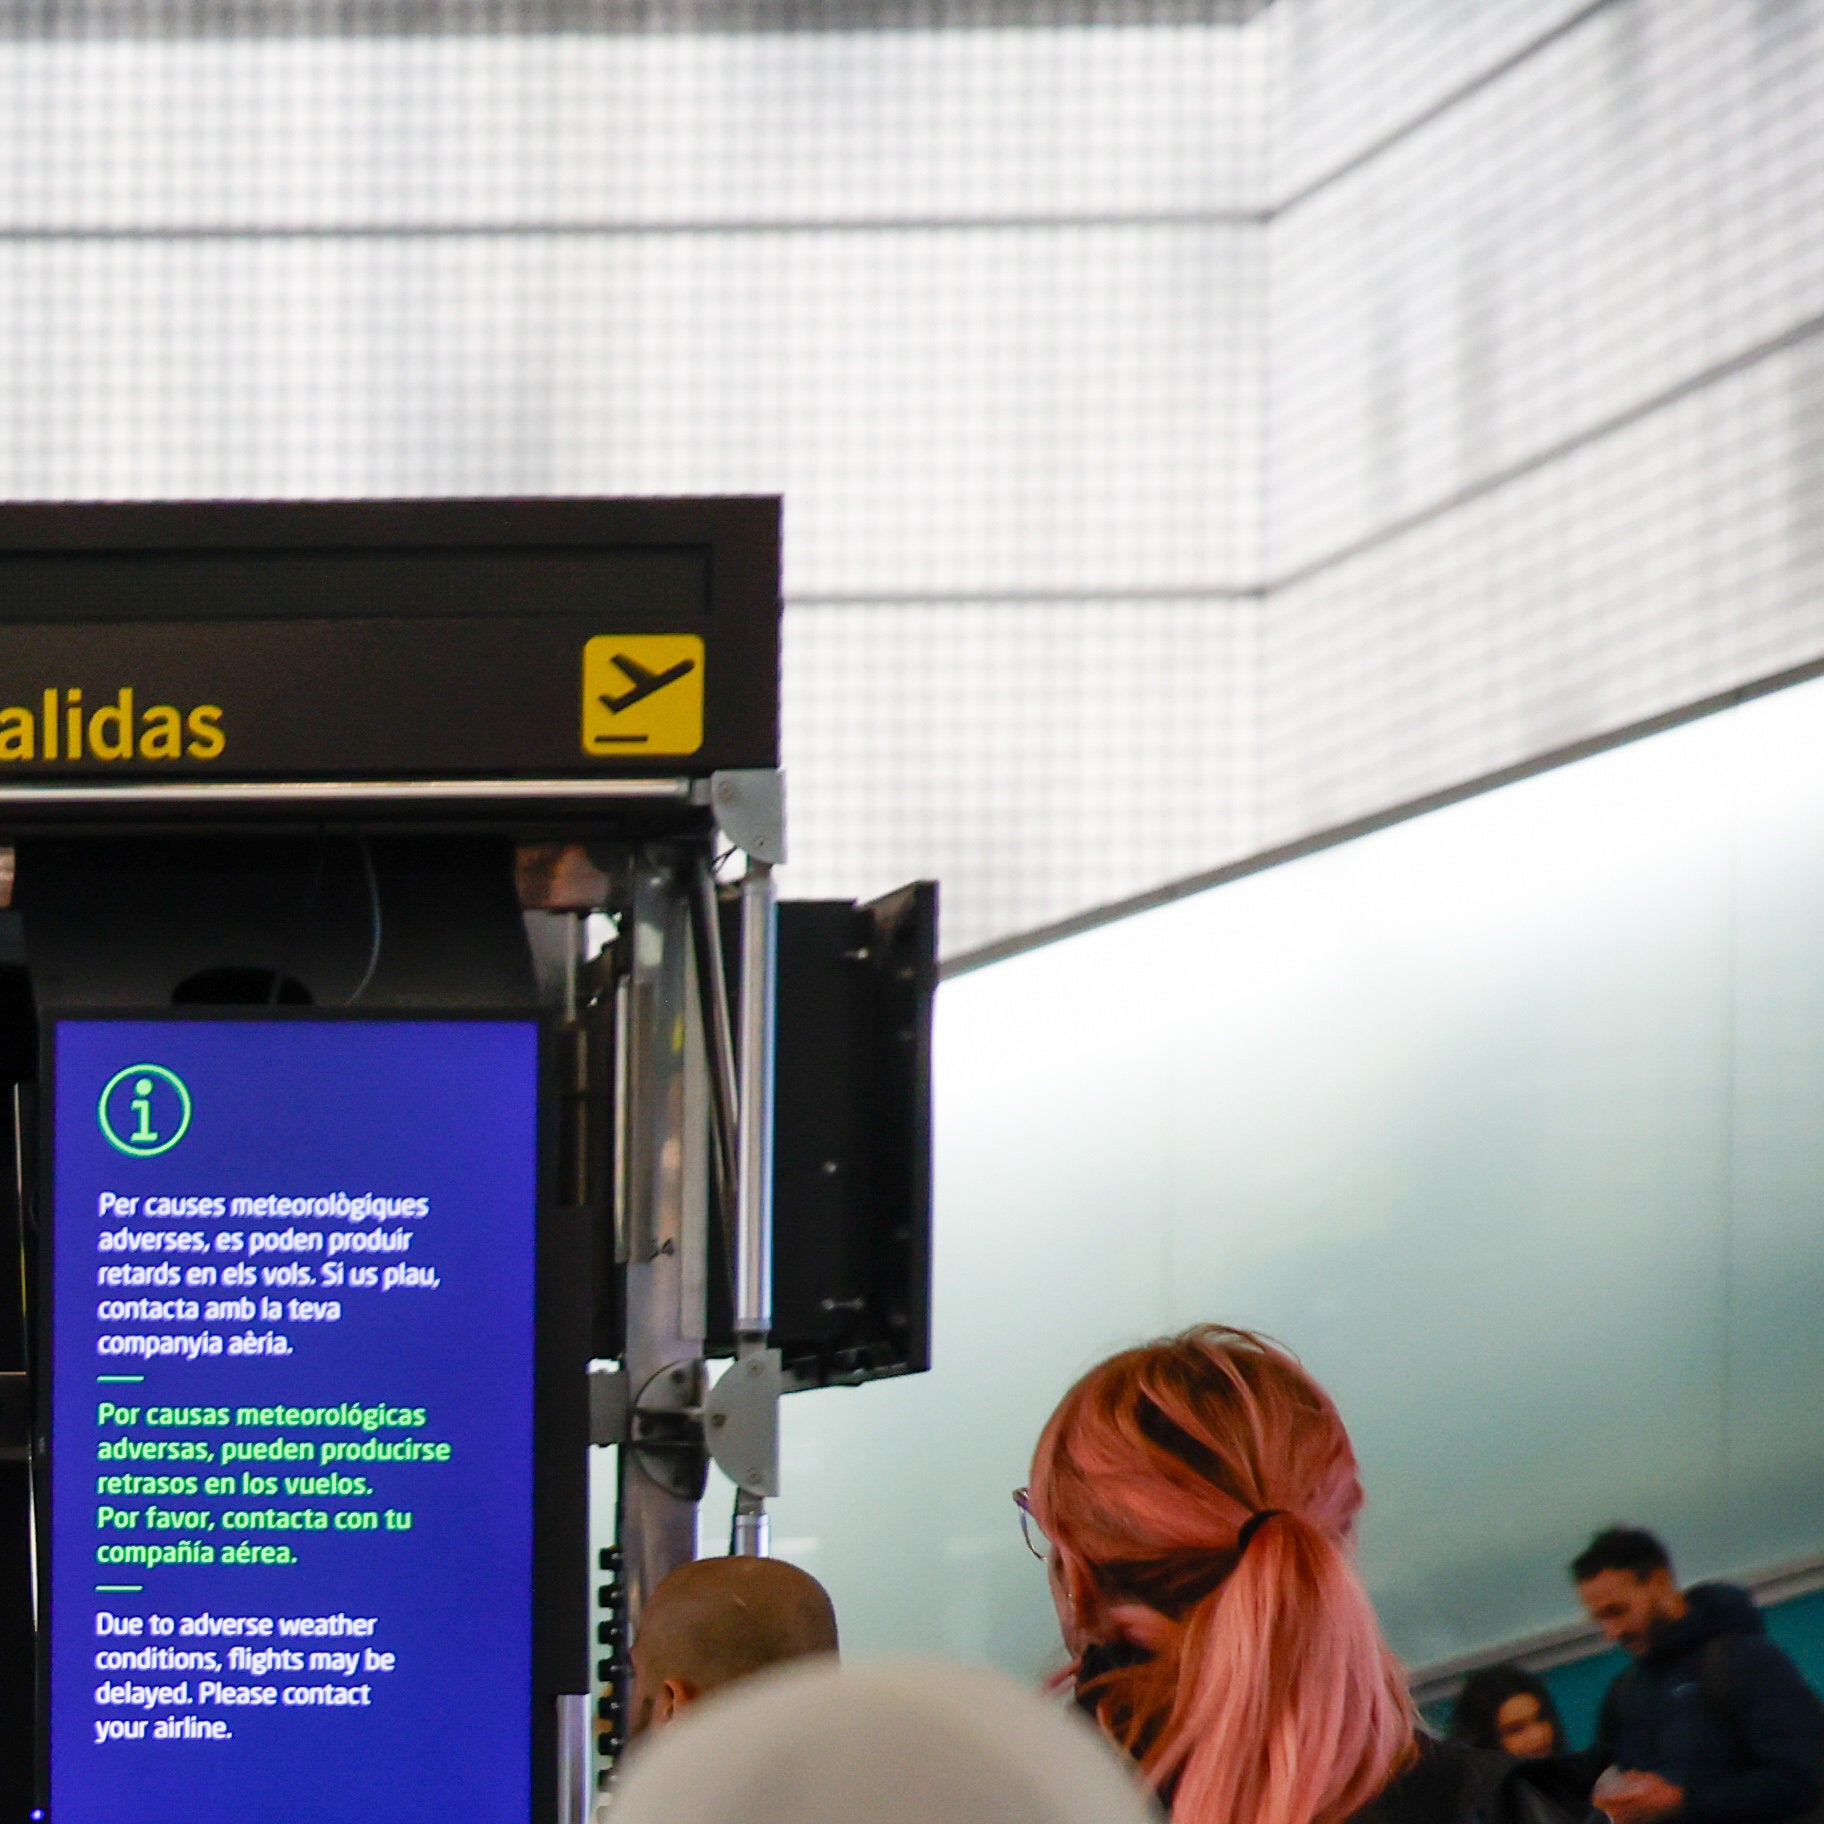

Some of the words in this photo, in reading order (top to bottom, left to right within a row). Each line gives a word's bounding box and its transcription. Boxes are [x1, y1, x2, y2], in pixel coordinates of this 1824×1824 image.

[98, 1191, 140, 1217] Per
[144, 1197, 226, 1218] causes
[230, 1191, 430, 1223] meteorològiques
[98, 1226, 211, 1254] adverses,
[215, 1231, 244, 1252] es
[248, 1226, 324, 1256] poden
[327, 1226, 414, 1257] produir
[98, 1261, 182, 1286] retards
[186, 1266, 217, 1286] en
[221, 1261, 258, 1286] els
[262, 1261, 317, 1287] vols.
[321, 1261, 344, 1287] Si
[348, 1266, 379, 1287] us
[382, 1261, 441, 1291] plau,
[97, 1297, 200, 1321] contacta
[204, 1296, 256, 1321] amb
[260, 1296, 283, 1321] la
[287, 1298, 341, 1321] teva
[97, 1330, 223, 1360] companyia
[227, 1329, 294, 1356] aèria.
[97, 1402, 141, 1426] Por
[145, 1407, 231, 1426] causas
[236, 1402, 427, 1432] meteorológicas
[97, 1436, 215, 1463] adversas,
[220, 1437, 315, 1466] pueden
[319, 1437, 452, 1466] producirse
[97, 1473, 199, 1496] retrasos
[203, 1476, 236, 1495] en
[241, 1471, 279, 1495] los
[284, 1471, 374, 1496] vuelos.
[97, 1506, 140, 1529] Por
[144, 1505, 216, 1532] favor,
[221, 1508, 329, 1530] contacta
[334, 1511, 379, 1530] con
[383, 1508, 412, 1531] tu
[96, 1539, 215, 1569] compañía
[220, 1539, 298, 1565] aérea.
[96, 1611, 144, 1637] Due
[148, 1614, 175, 1636] to
[179, 1612, 274, 1637] adverse
[278, 1612, 378, 1637] weather
[95, 1646, 223, 1673] conditions,
[227, 1646, 305, 1676] flights
[309, 1652, 360, 1676] may
[364, 1647, 396, 1672] be
[94, 1680, 194, 1710] delayed.
[198, 1681, 278, 1706] Please
[282, 1683, 372, 1706] contact
[94, 1720, 149, 1744] your
[153, 1715, 233, 1740] airline.
